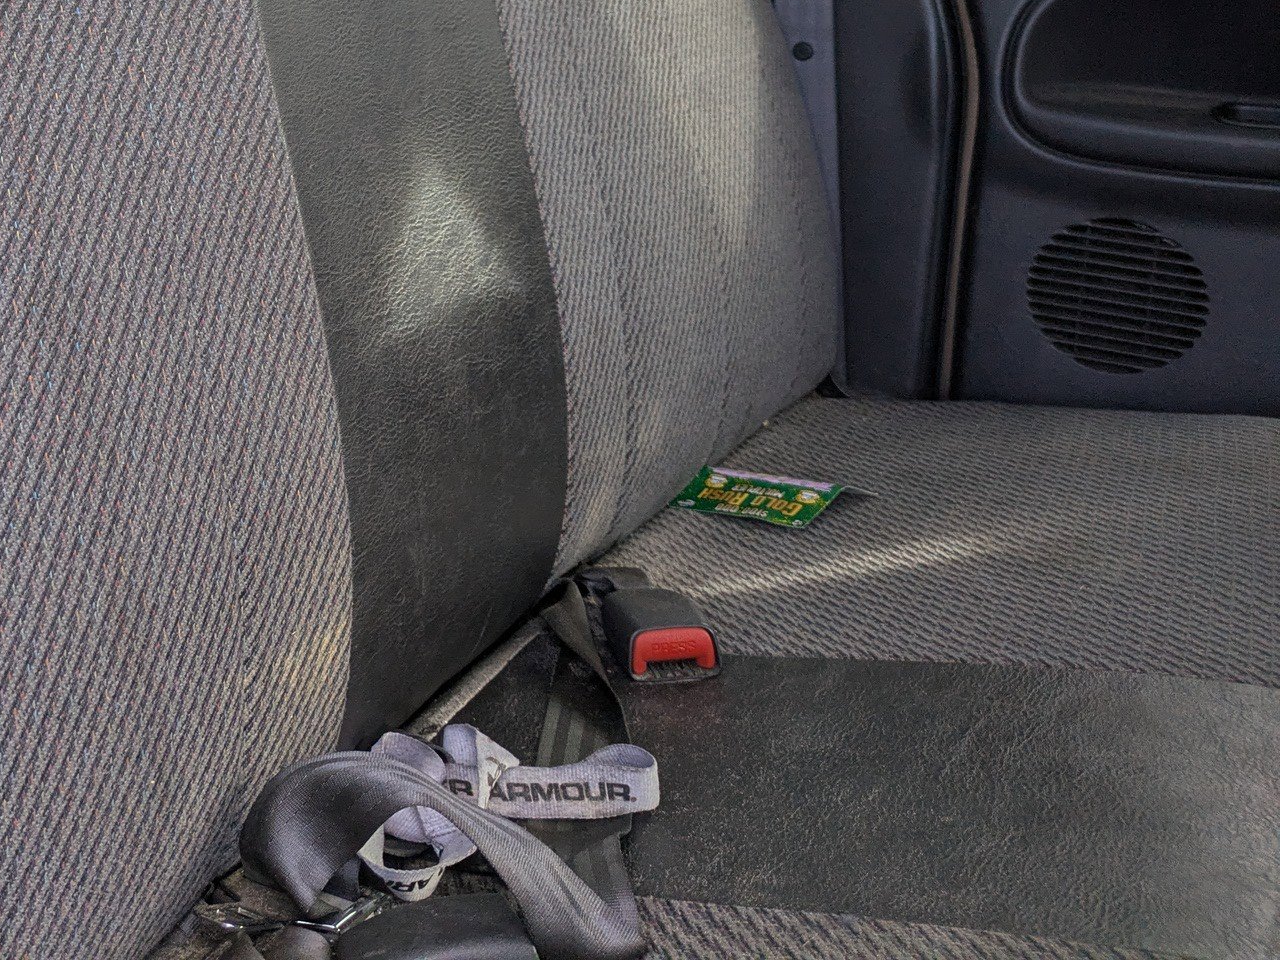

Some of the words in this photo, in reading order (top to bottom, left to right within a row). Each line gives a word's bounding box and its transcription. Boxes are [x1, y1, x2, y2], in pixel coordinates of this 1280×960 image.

[697, 487, 749, 506] RUSH
[750, 495, 803, 516] GOLD
[650, 640, 697, 653] PRESS
